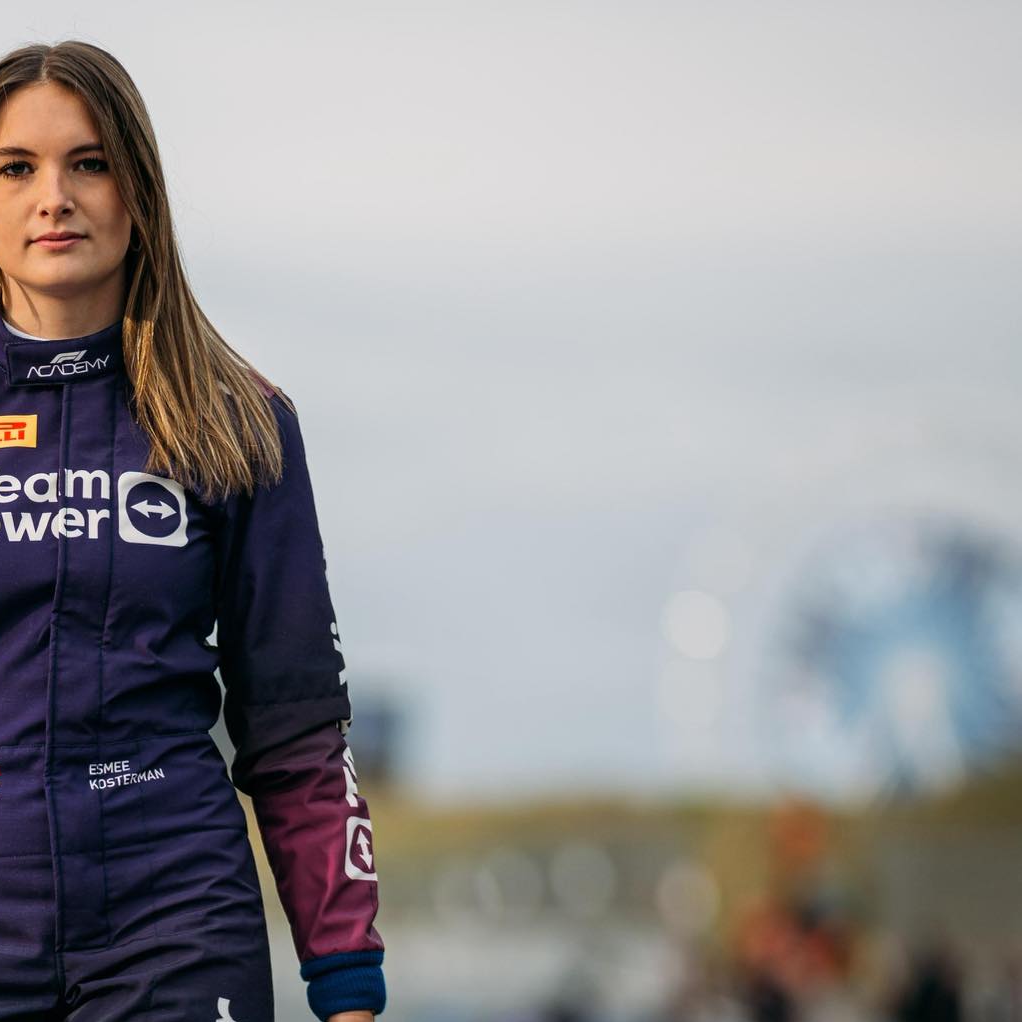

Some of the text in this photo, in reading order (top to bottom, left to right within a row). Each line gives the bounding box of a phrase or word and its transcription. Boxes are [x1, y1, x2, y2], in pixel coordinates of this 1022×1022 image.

[26, 354, 110, 379] ACADEMY
[89, 760, 130, 775] ESMEE
[89, 768, 165, 790] KOSTERMAN
